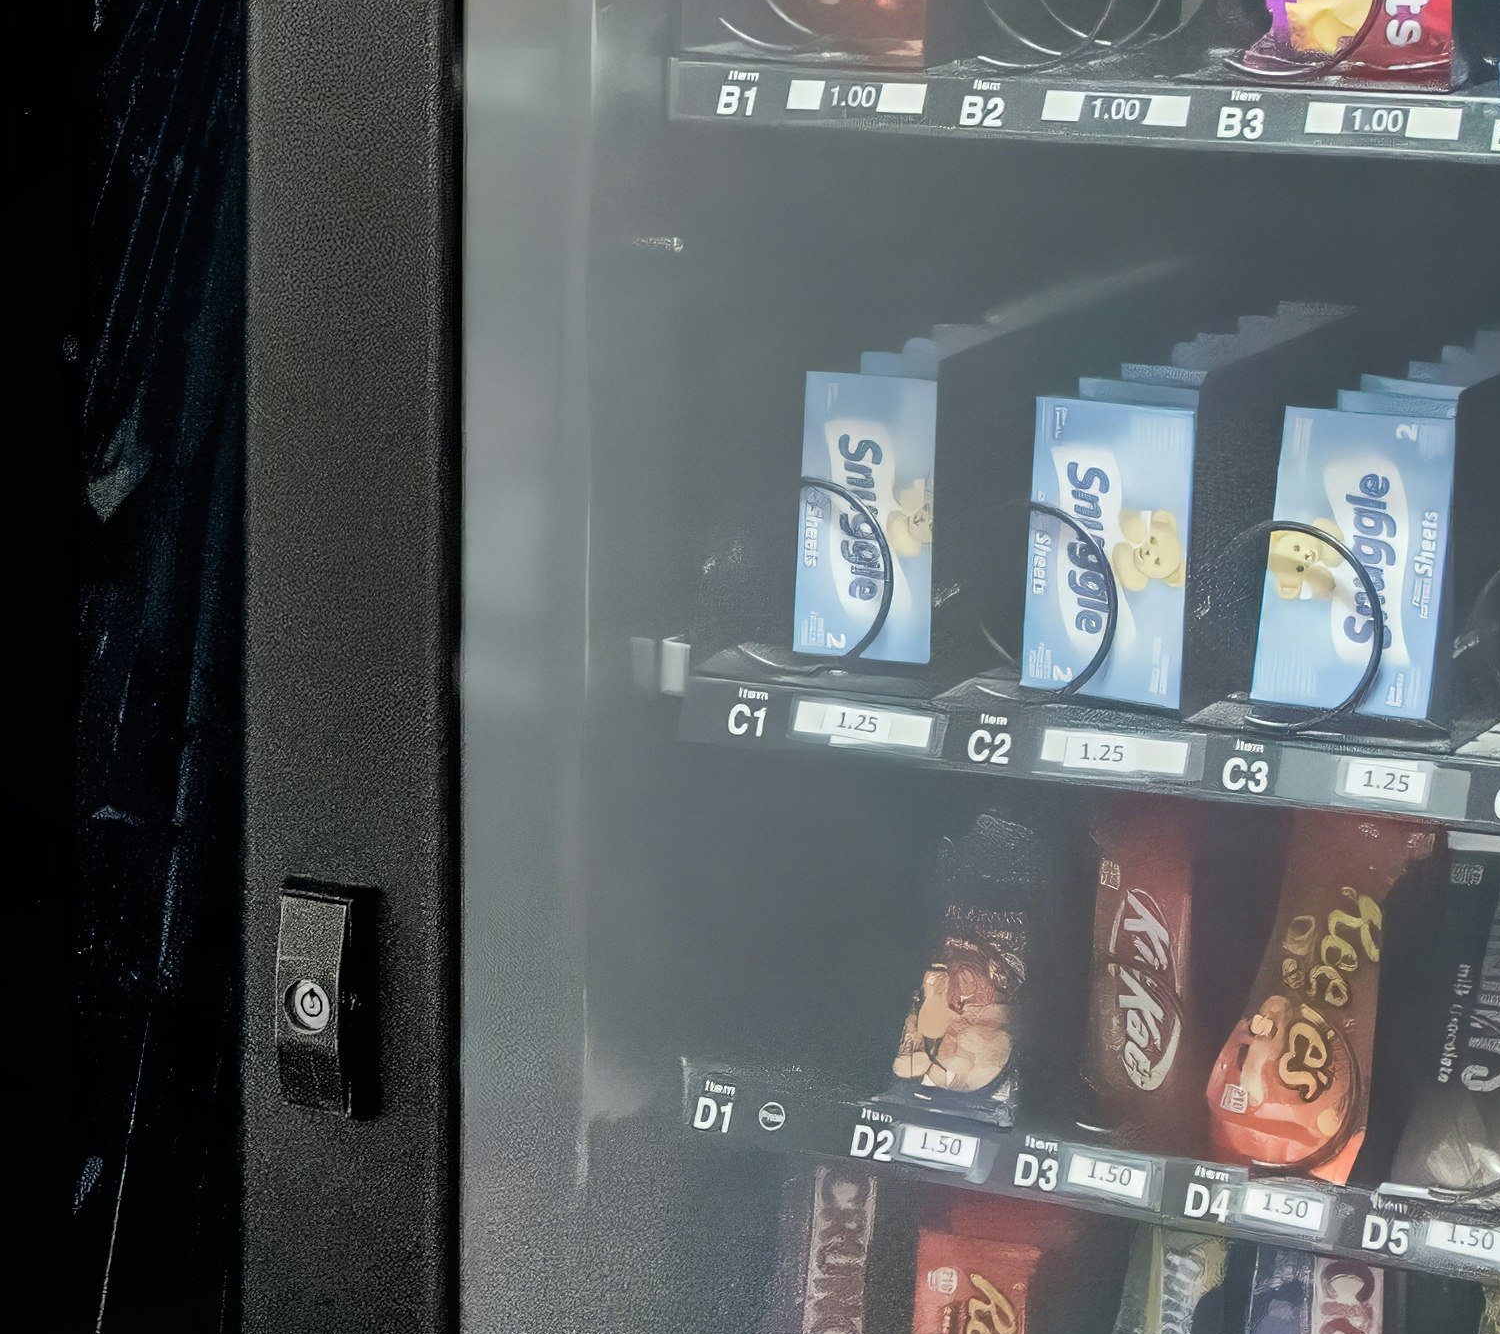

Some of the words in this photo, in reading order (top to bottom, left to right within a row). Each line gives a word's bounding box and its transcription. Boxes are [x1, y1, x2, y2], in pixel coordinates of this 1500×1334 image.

[716, 85, 757, 116] B1
[829, 84, 876, 108] 1.00
[960, 97, 1006, 127] B2
[1092, 97, 1141, 122] 1.00
[1217, 107, 1264, 139] B3
[1350, 108, 1404, 132] 1.00
[838, 432, 884, 603] Snuggle
[1066, 460, 1111, 636] Snuggle
[1343, 470, 1397, 651] Snuggle
[727, 703, 768, 738] C1
[837, 710, 879, 735] 1.25
[967, 731, 1013, 766] C2
[1079, 740, 1125, 764] 1.25
[1222, 757, 1270, 793] C3
[1362, 768, 1411, 793] 1.25
[693, 1097, 733, 1134] D1
[851, 1124, 896, 1162] D2
[919, 1130, 963, 1157] 1.50
[1015, 1154, 1059, 1192] D3
[1086, 1161, 1134, 1187] 1.50
[1184, 1182, 1230, 1223] D4
[1262, 1193, 1310, 1218] 1.50
[1363, 1215, 1411, 1256] D5
[1446, 1226, 1497, 1253] 1.50
